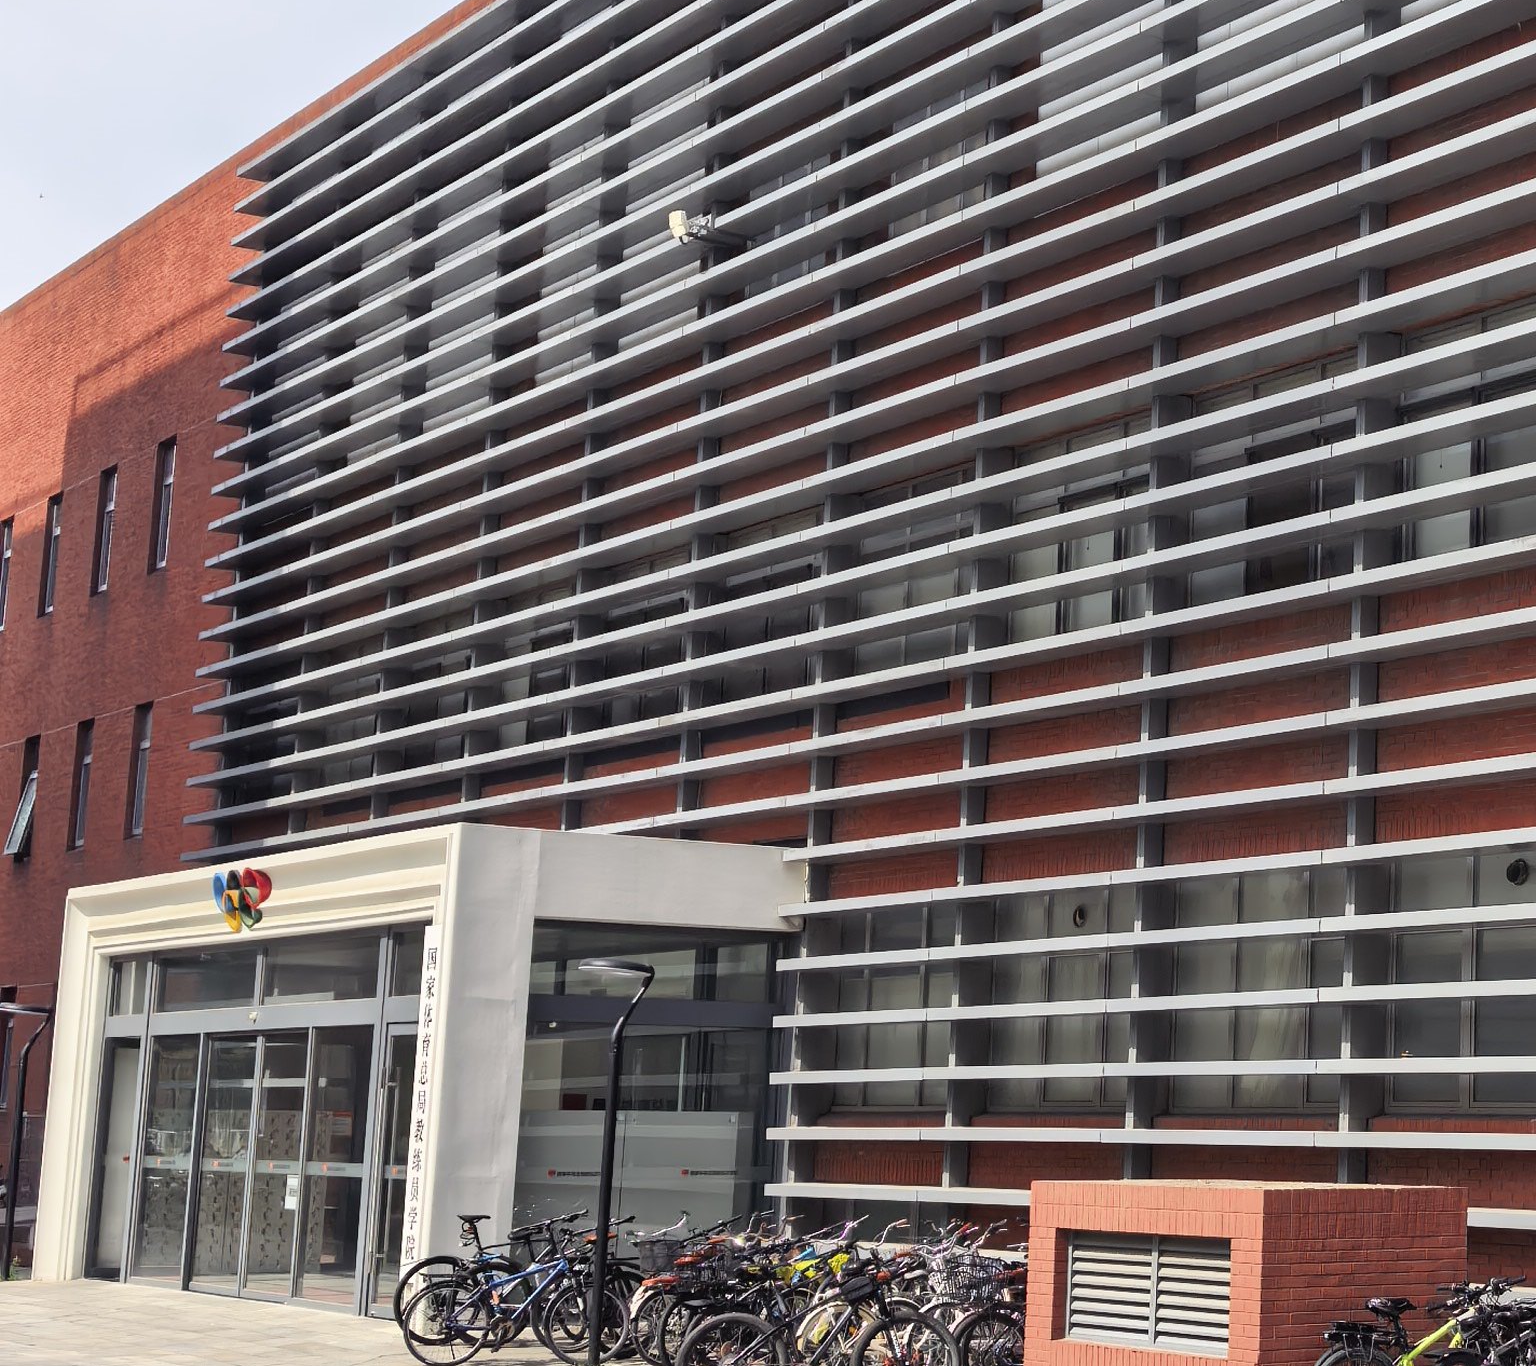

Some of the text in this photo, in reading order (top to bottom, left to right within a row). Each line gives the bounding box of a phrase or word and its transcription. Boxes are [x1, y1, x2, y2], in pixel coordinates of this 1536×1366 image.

[405, 947, 438, 1260] 国家体育总局教练员学院
